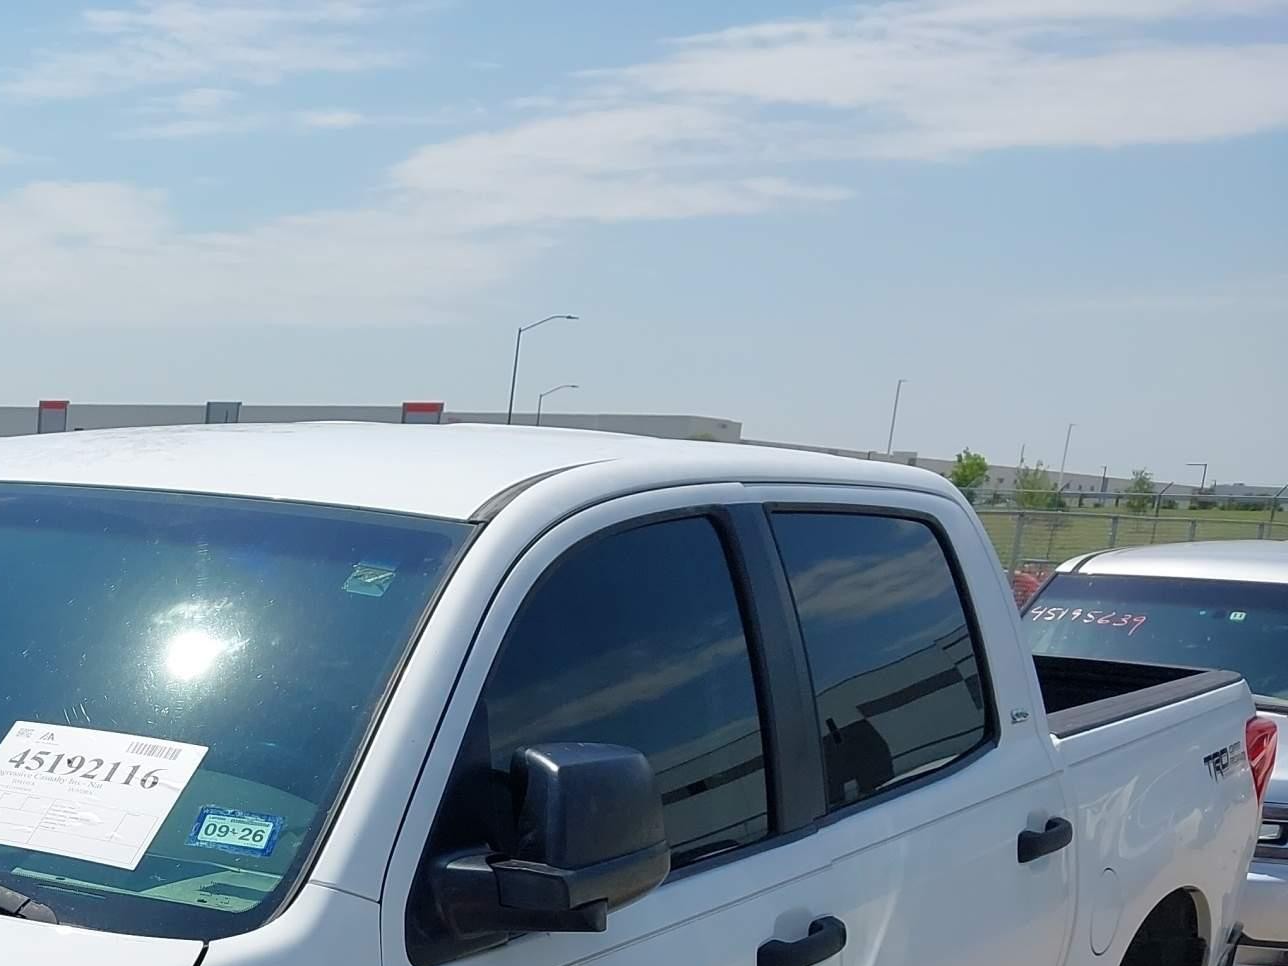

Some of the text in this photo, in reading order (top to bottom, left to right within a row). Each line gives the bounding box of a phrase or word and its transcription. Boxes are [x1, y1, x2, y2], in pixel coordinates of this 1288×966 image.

[1030, 605, 1147, 636] 45195639
[8, 748, 169, 790] 45192116
[1203, 747, 1229, 782] TRD
[204, 823, 230, 838] 09
[238, 827, 266, 843] 26
